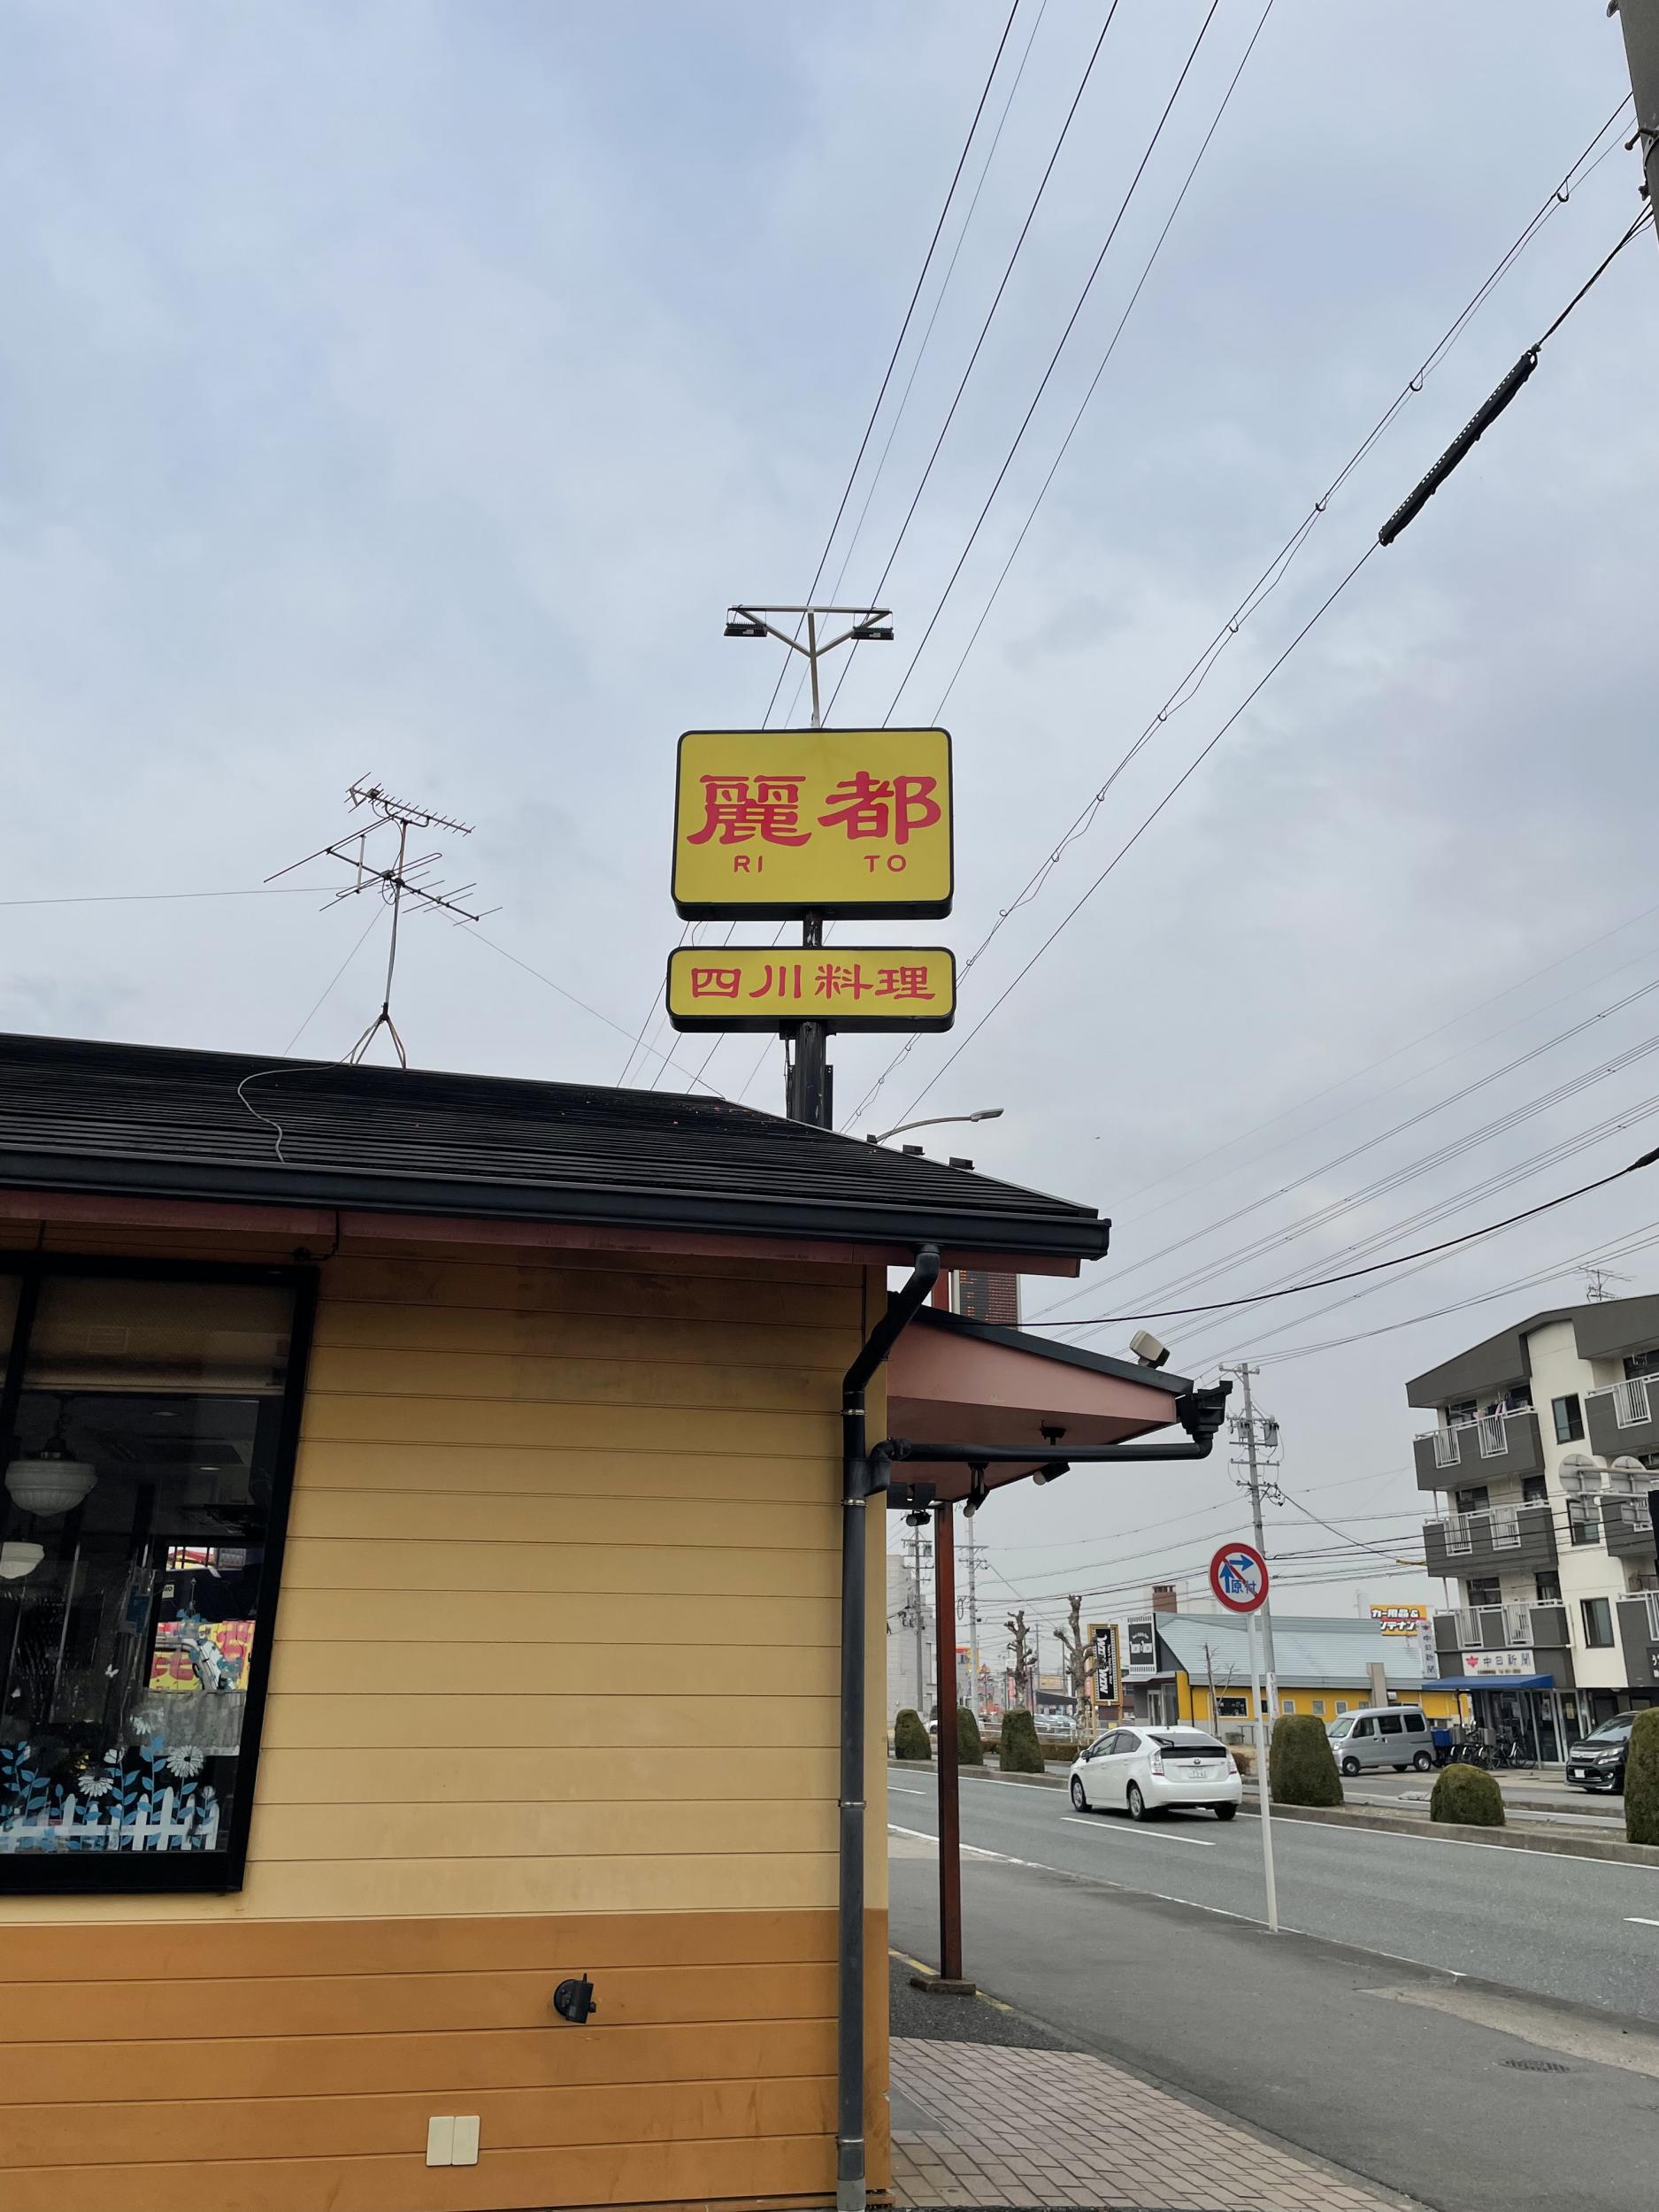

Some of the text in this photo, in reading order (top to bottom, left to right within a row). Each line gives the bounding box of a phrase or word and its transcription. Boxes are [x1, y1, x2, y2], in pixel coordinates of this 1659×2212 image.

[687, 771, 941, 847] 麗都
[733, 854, 907, 873] RI TO
[690, 963, 936, 1001] 四川料理
[1231, 1579, 1256, 1594] 原付
[1483, 1652, 1532, 1668] 中日新聞
